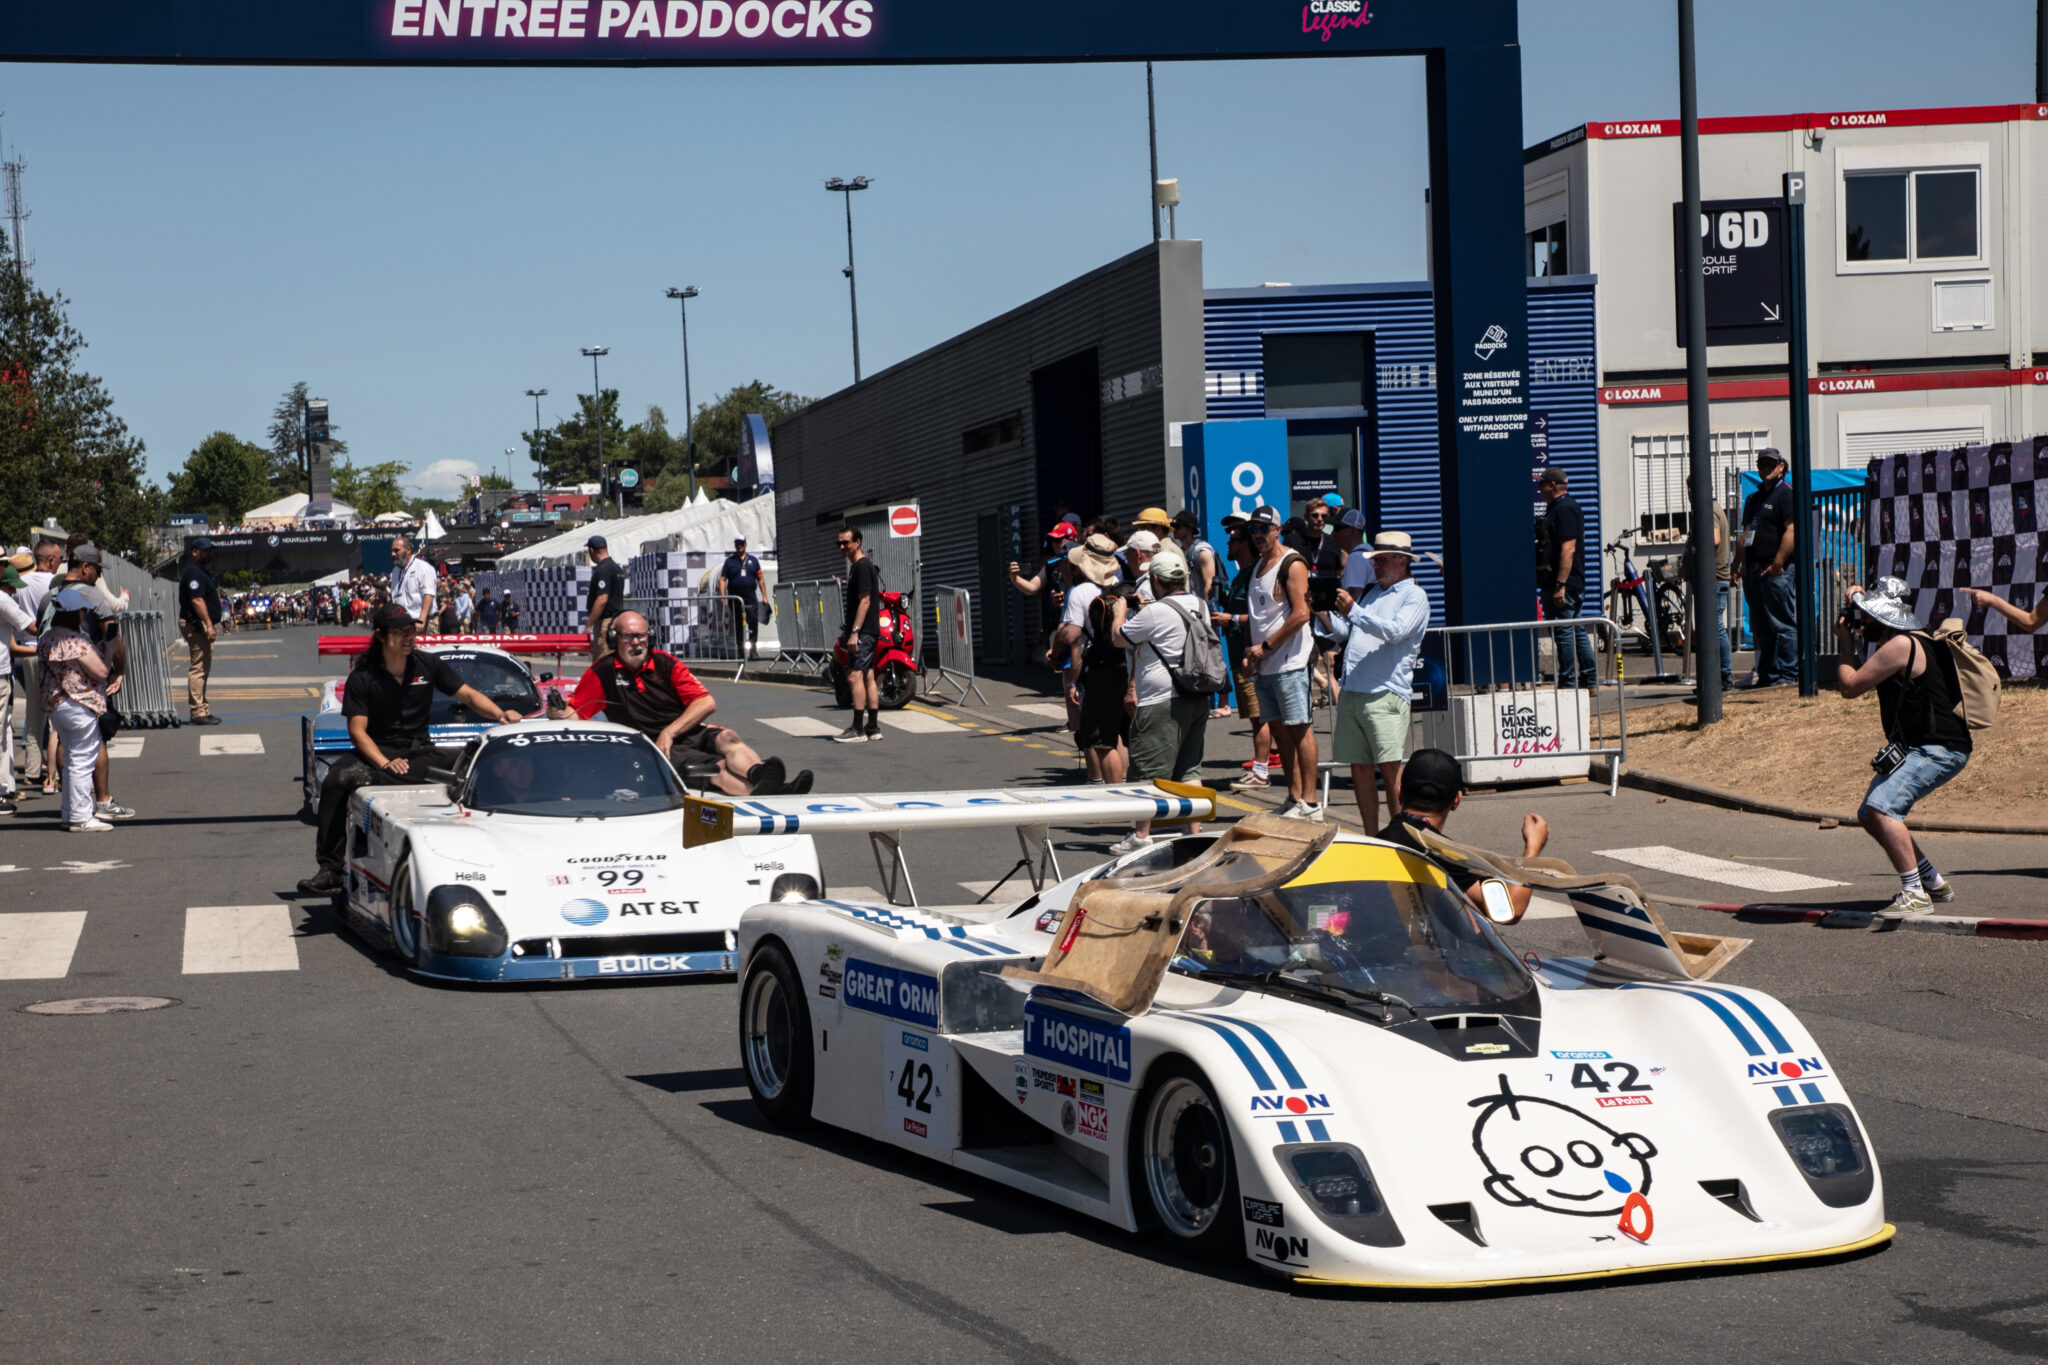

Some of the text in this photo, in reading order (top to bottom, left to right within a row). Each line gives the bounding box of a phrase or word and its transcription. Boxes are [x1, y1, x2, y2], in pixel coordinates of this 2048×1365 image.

[1310, 1, 1361, 13] CLASSIC
[391, 0, 873, 38] ENTREE PADDOCKS
[1302, 1, 1370, 42] Legend
[1842, 114, 1887, 126] LOXAM
[1615, 124, 1662, 136] LOXAM
[1790, 179, 1804, 197] P
[1719, 210, 1769, 250] 6D
[1475, 342, 1508, 350] PADDOCKS
[1484, 370, 1521, 379] RÉSERVÉE
[1534, 358, 1593, 383] ENTRY
[1482, 380, 1520, 388] VISITEURS
[1830, 379, 1876, 392] LOXAM
[1483, 397, 1523, 405] PADDOCKS
[1615, 388, 1662, 400] LOXAM
[1484, 423, 1524, 431] PADDOCKS
[1479, 432, 1509, 440] ACCESS
[1501, 704, 1515, 716] LE
[1502, 715, 1536, 728] MANS
[534, 734, 632, 744] BUICK
[1502, 726, 1552, 740] CLASSIC
[567, 853, 667, 864] GOODYEAR
[754, 860, 784, 871] Hella
[455, 872, 486, 881] Hella
[597, 870, 644, 887] 99
[620, 901, 700, 917] AT&T
[598, 955, 692, 974] BUICK
[846, 969, 894, 1006] GREAT
[903, 1033, 928, 1050] aramco
[1043, 1018, 1129, 1070] HOSPITAL
[1557, 1051, 1607, 1059] aramco
[1032, 1067, 1057, 1083] THUNDER
[1747, 1057, 1823, 1079] AVON
[1545, 1074, 1553, 1082] 7
[1570, 1062, 1654, 1093] 42
[897, 1058, 933, 1114] 42
[1033, 1078, 1055, 1093] SPORTS
[1250, 1094, 1330, 1115] AVON
[1600, 1096, 1649, 1106] Le Point
[1079, 1101, 1107, 1133] NGK
[905, 1119, 926, 1137] Le Point
[1245, 1199, 1281, 1214] EXPOSURE
[1252, 1210, 1273, 1223] LIGHTS
[1256, 1228, 1309, 1261] AVON
